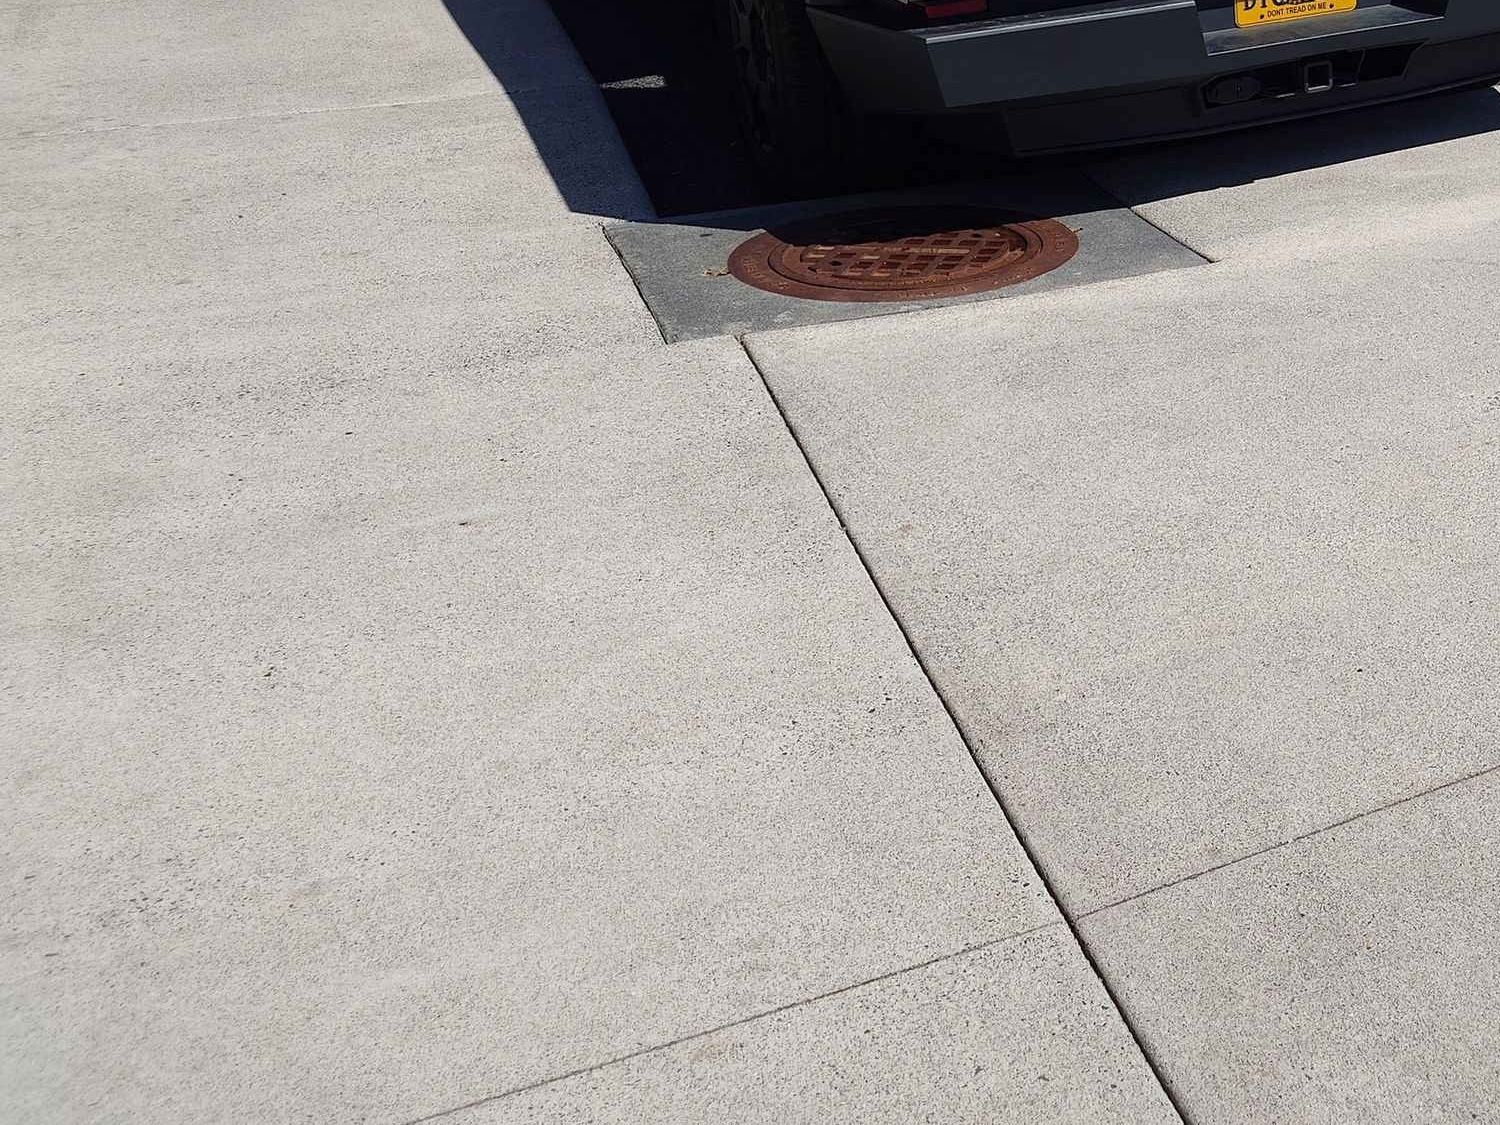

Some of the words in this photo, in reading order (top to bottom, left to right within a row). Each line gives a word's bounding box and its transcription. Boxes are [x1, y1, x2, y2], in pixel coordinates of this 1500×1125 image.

[1267, 9, 1284, 18] DONT
[1286, 6, 1307, 15] TREAD
[1317, 2, 1327, 10] ME
